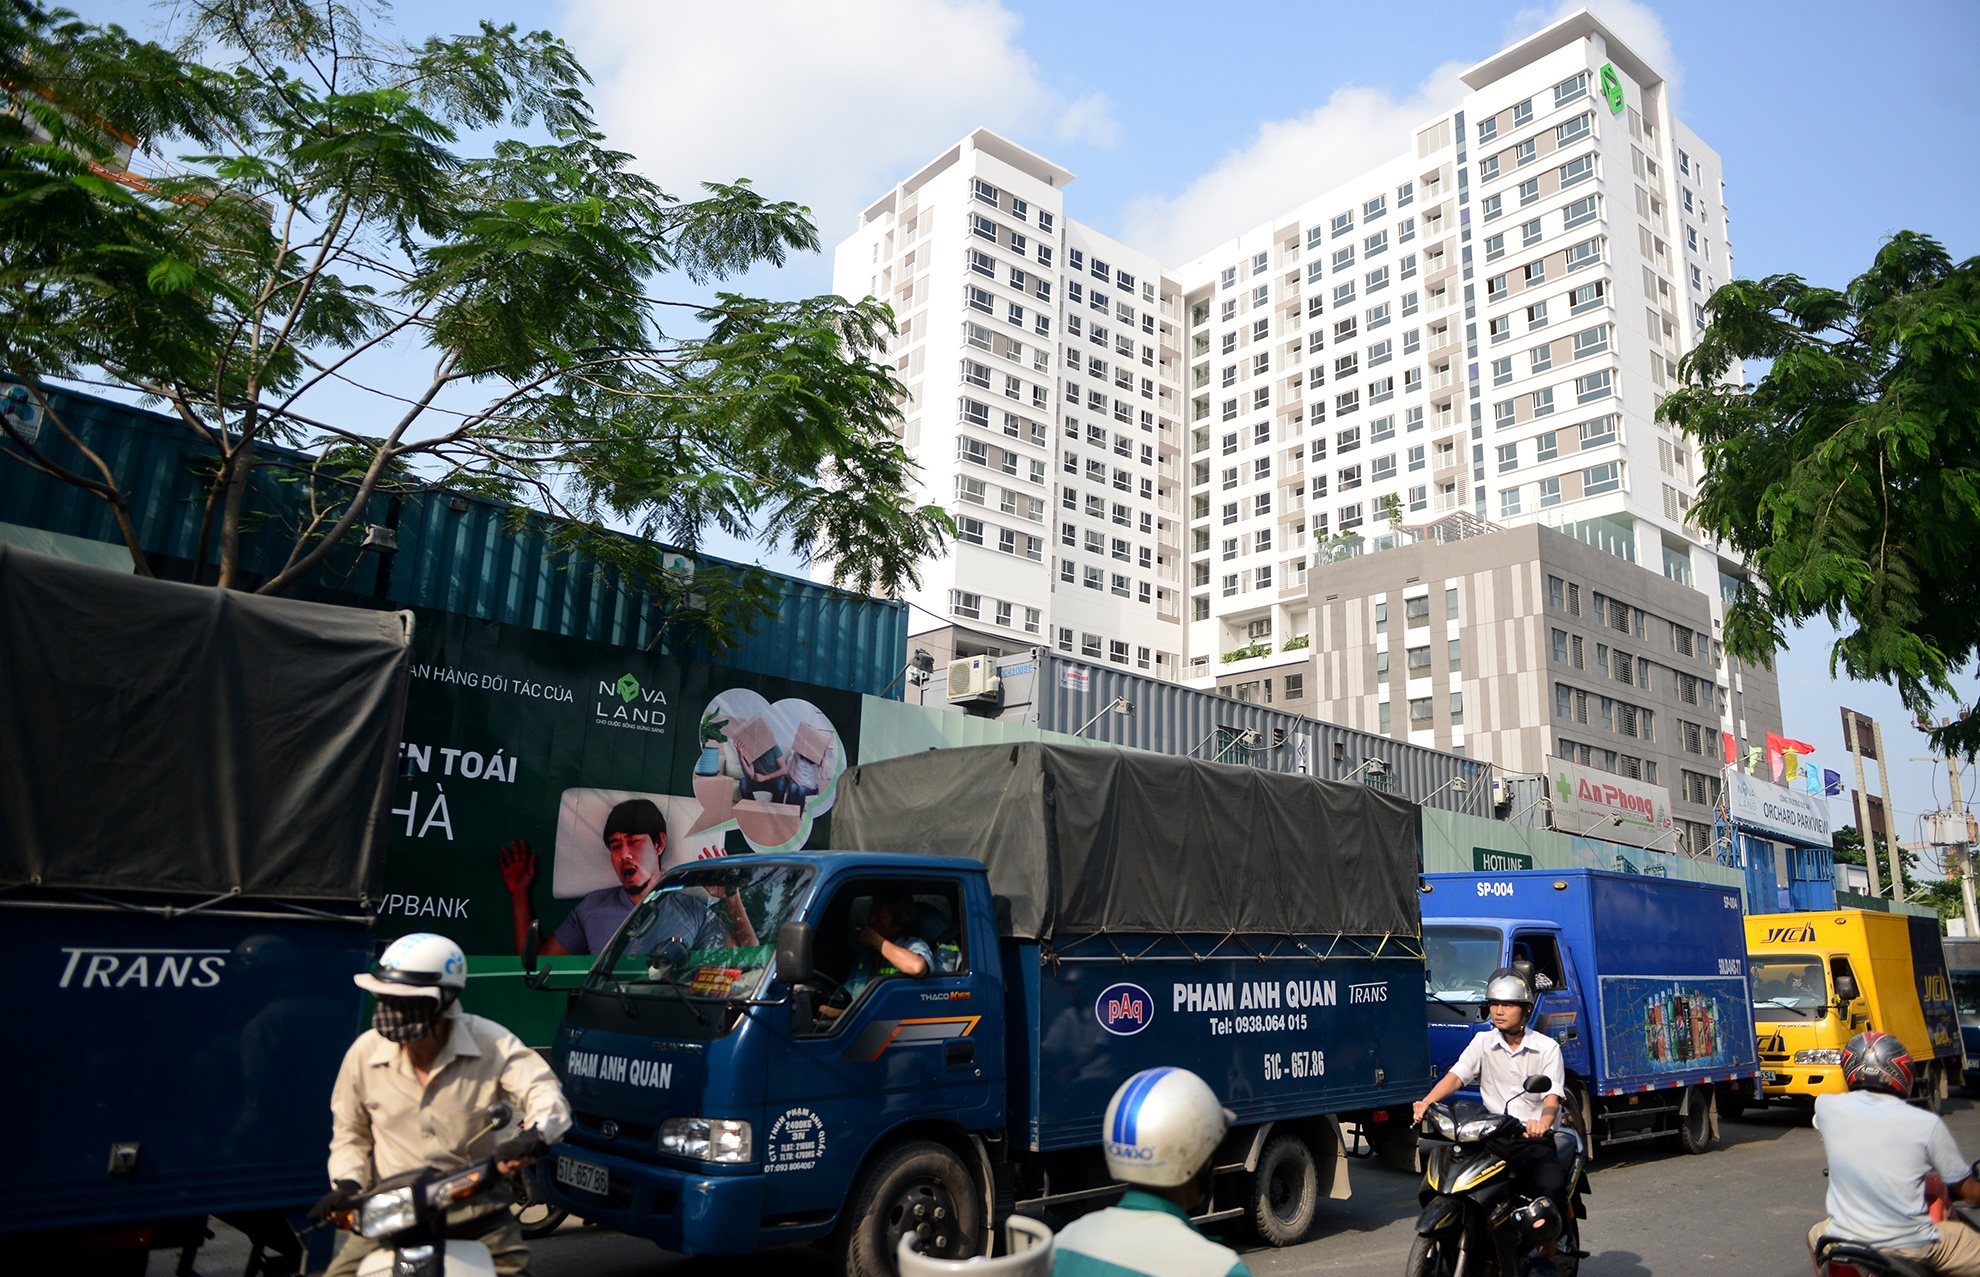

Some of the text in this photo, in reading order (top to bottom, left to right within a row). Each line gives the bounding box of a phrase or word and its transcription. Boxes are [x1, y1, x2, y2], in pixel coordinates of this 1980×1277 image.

[433, 666, 479, 687] HÀNG
[481, 674, 507, 692] ĐỐI
[512, 679, 541, 698] TÁC
[544, 684, 574, 703] CỦA
[596, 702, 666, 726] LAND
[440, 748, 518, 783] TOÁI
[1578, 778, 1654, 823] An Phong
[1739, 800, 1757, 811] LAND
[1763, 802, 1829, 835] ORCHARD PARKVIEW
[1482, 853, 1523, 871] HOTLINE
[1476, 882, 1514, 897] SP-004
[377, 894, 470, 919] VPBANK
[59, 947, 231, 988] TRANS
[920, 993, 950, 1001] THACO
[1173, 980, 1388, 1012] PHAM ANH QUAN TRANS
[1210, 1014, 1308, 1036] Tel: 0938.064 015
[568, 1050, 672, 1090] PHAM ANH QUAN
[1264, 1052, 1282, 1080] 51C
[1291, 1050, 1324, 1078] 657.86
[769, 1116, 786, 1140] TNHH
[809, 1112, 824, 1130] ANH
[768, 1144, 777, 1162] CTY
